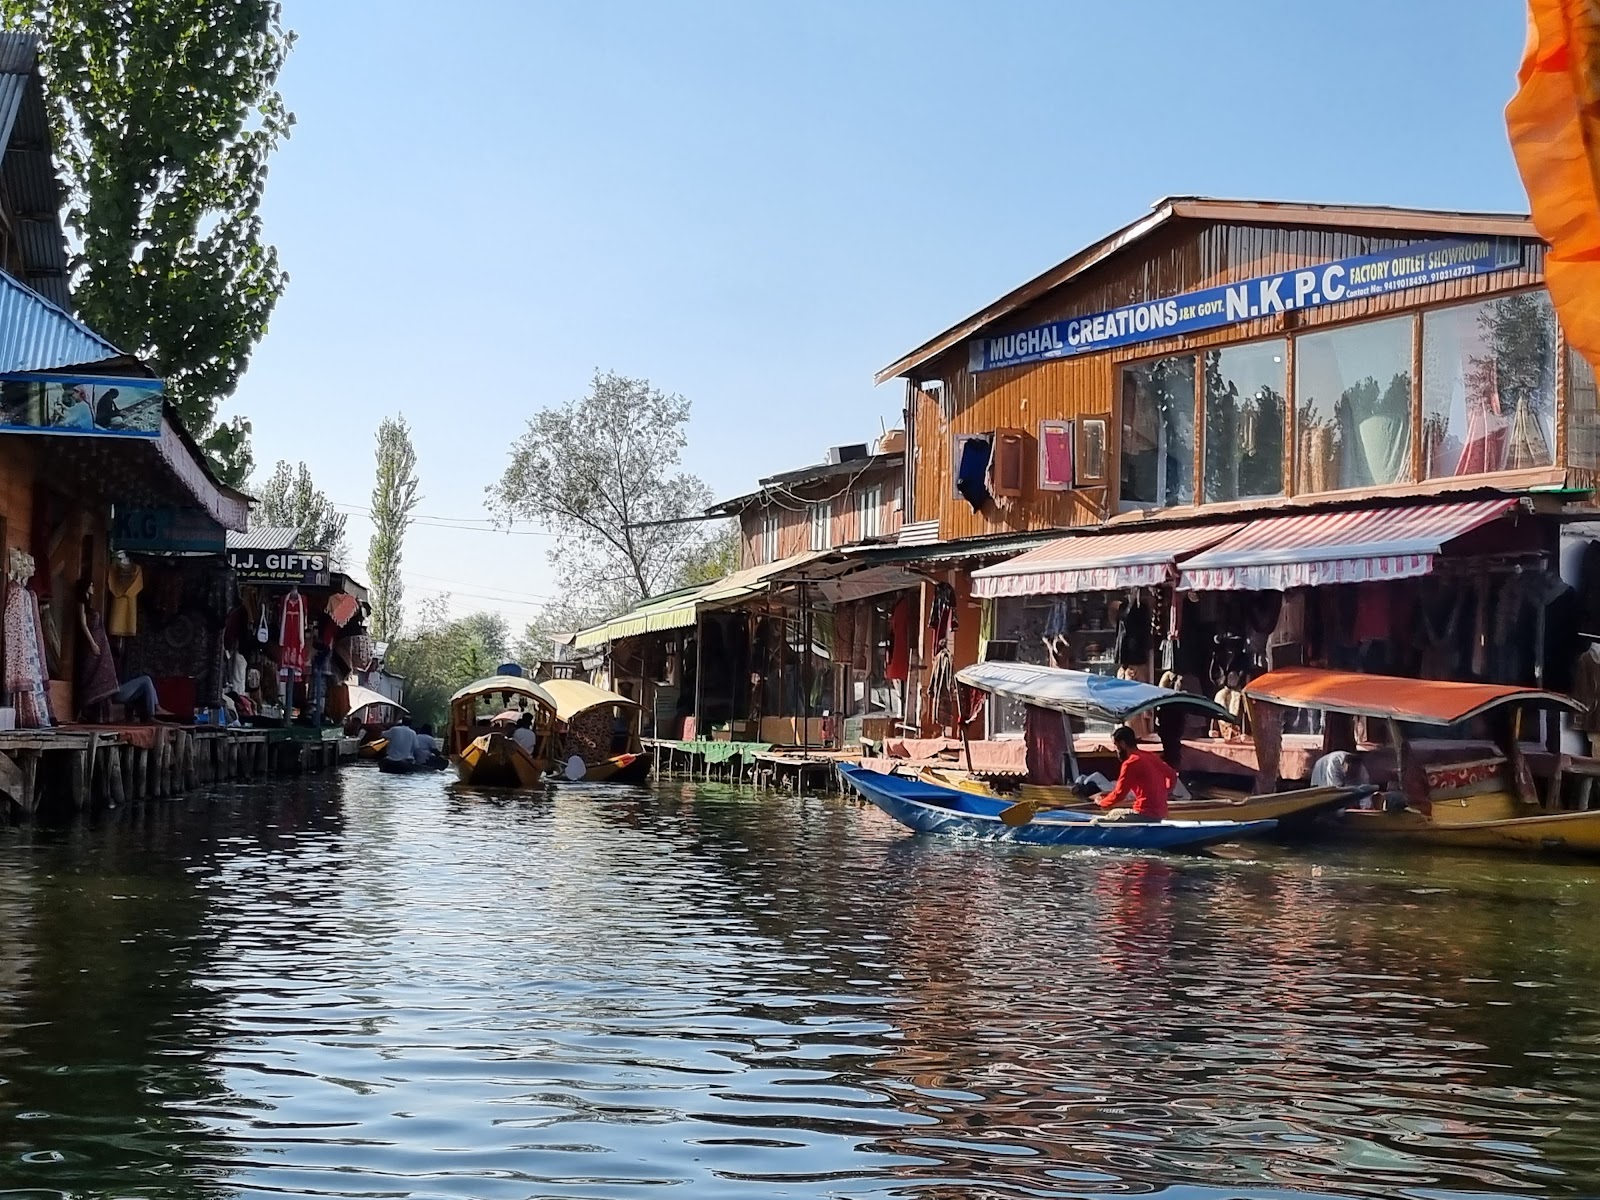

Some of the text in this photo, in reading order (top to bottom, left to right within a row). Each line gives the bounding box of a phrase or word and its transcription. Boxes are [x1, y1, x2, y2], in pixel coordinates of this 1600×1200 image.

[1350, 241, 1489, 285] FACTORY OUTLET SHOWROOM
[1346, 286, 1370, 298] Contact
[1370, 284, 1383, 294] No:
[990, 325, 1063, 361] MUGHAL
[1067, 301, 1178, 346] CREATIONS
[1179, 305, 1196, 321] J&K
[1198, 300, 1225, 316] GOVT.
[1226, 265, 1345, 321] N.K.P.C
[228, 554, 324, 571] J.J. GIFTS
